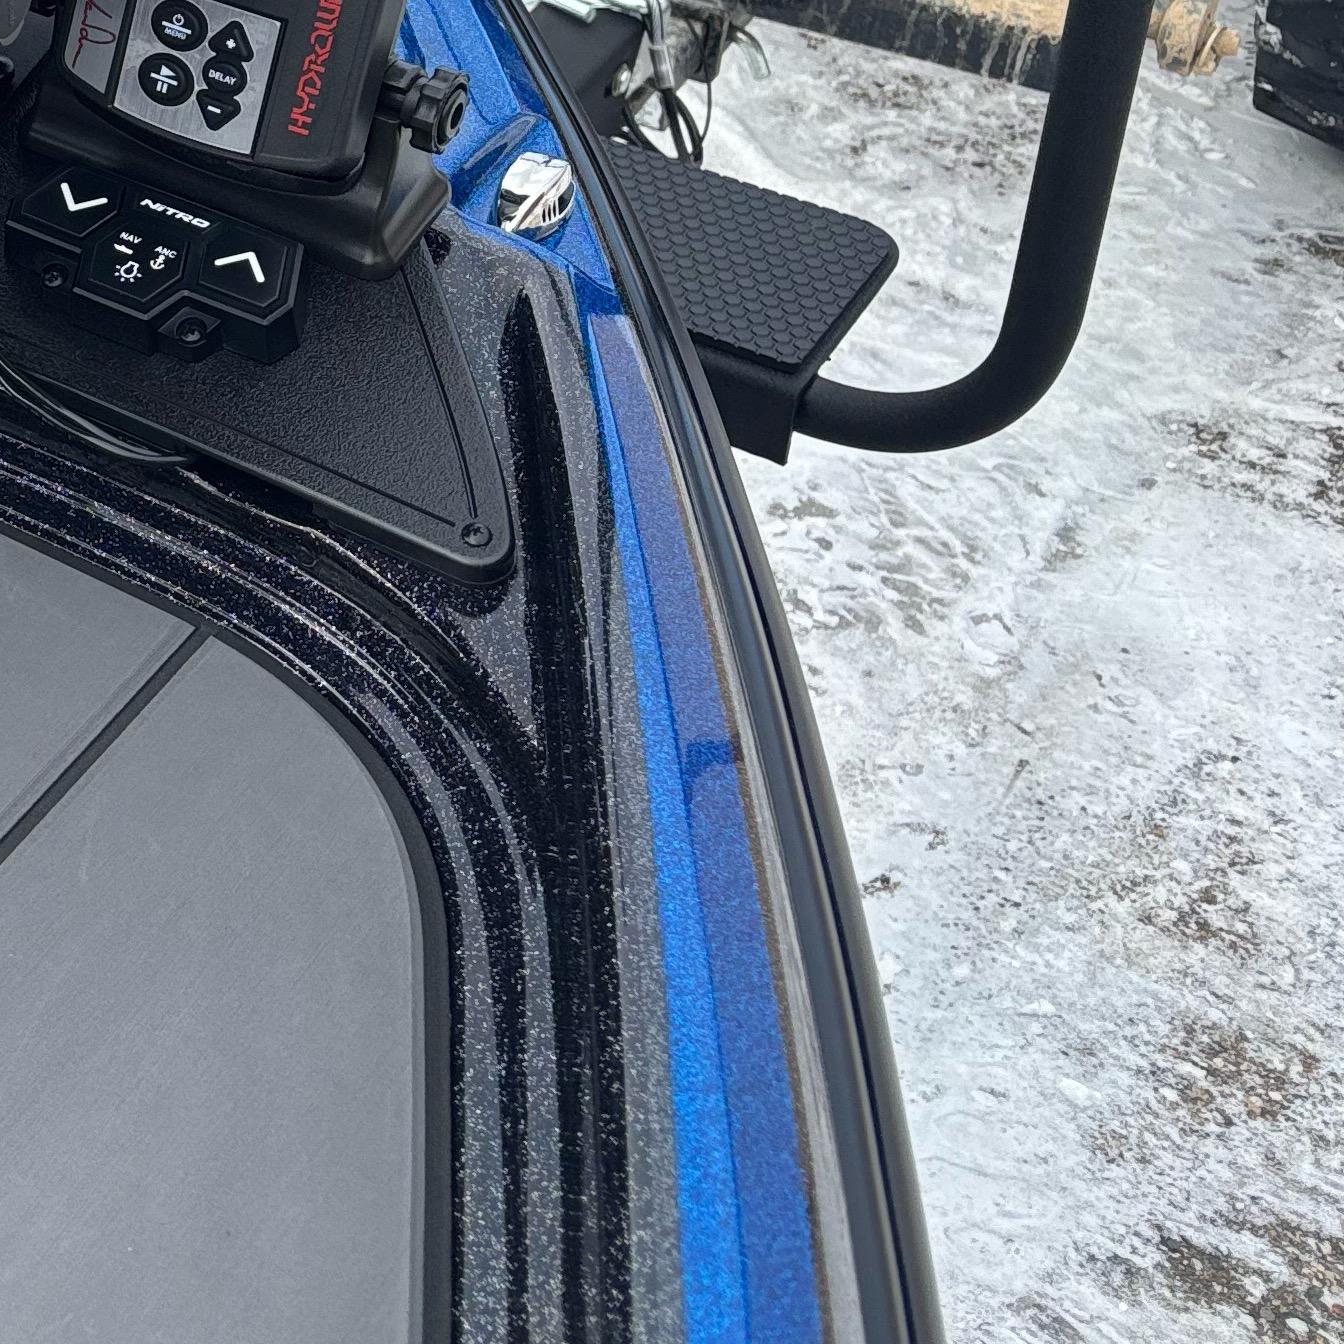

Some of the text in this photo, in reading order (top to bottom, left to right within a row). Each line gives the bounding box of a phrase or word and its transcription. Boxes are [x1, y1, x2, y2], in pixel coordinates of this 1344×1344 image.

[164, 26, 187, 41] MENU
[208, 68, 237, 86] DELAY
[140, 199, 211, 228] NITRO
[119, 231, 143, 244] NAV
[154, 245, 178, 258] ANC
